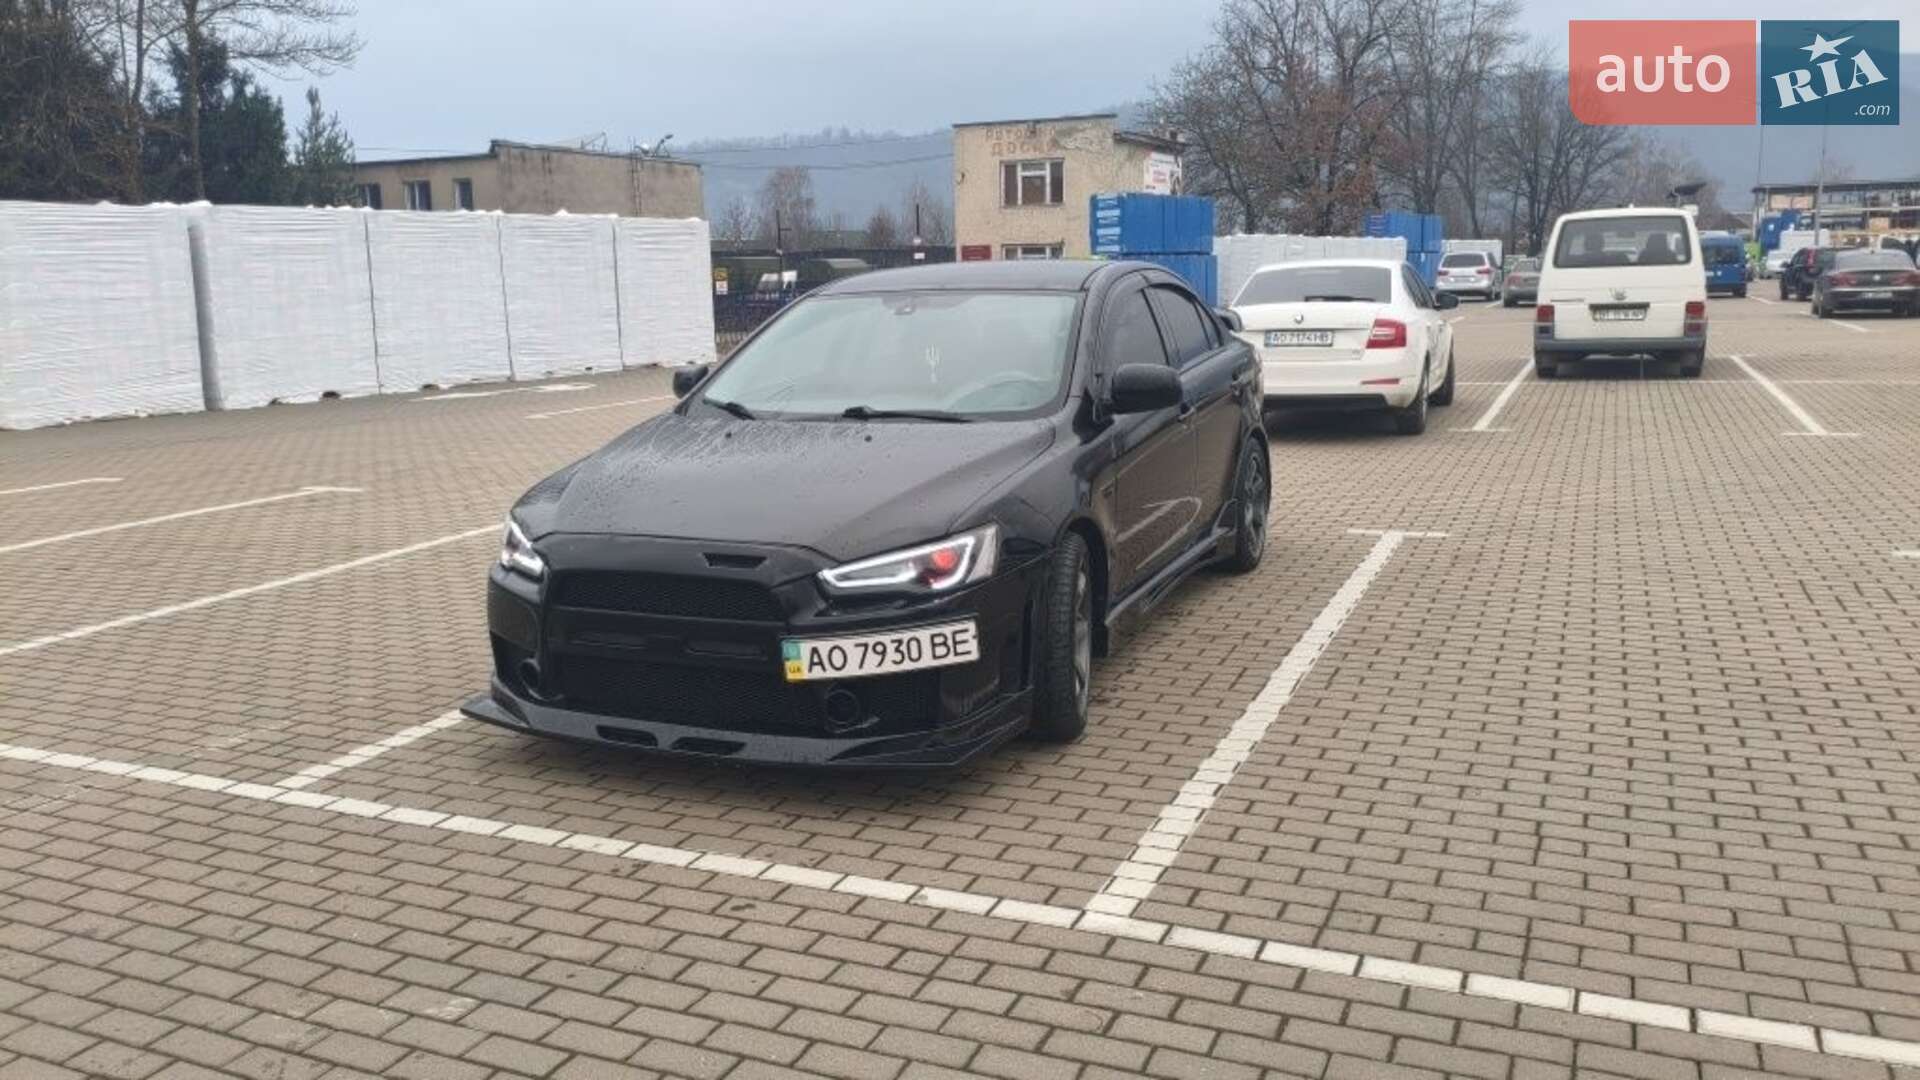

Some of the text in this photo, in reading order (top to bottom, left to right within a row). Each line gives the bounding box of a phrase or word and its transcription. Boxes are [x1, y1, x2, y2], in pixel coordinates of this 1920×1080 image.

[808, 629, 972, 673] AO 7930 BE
